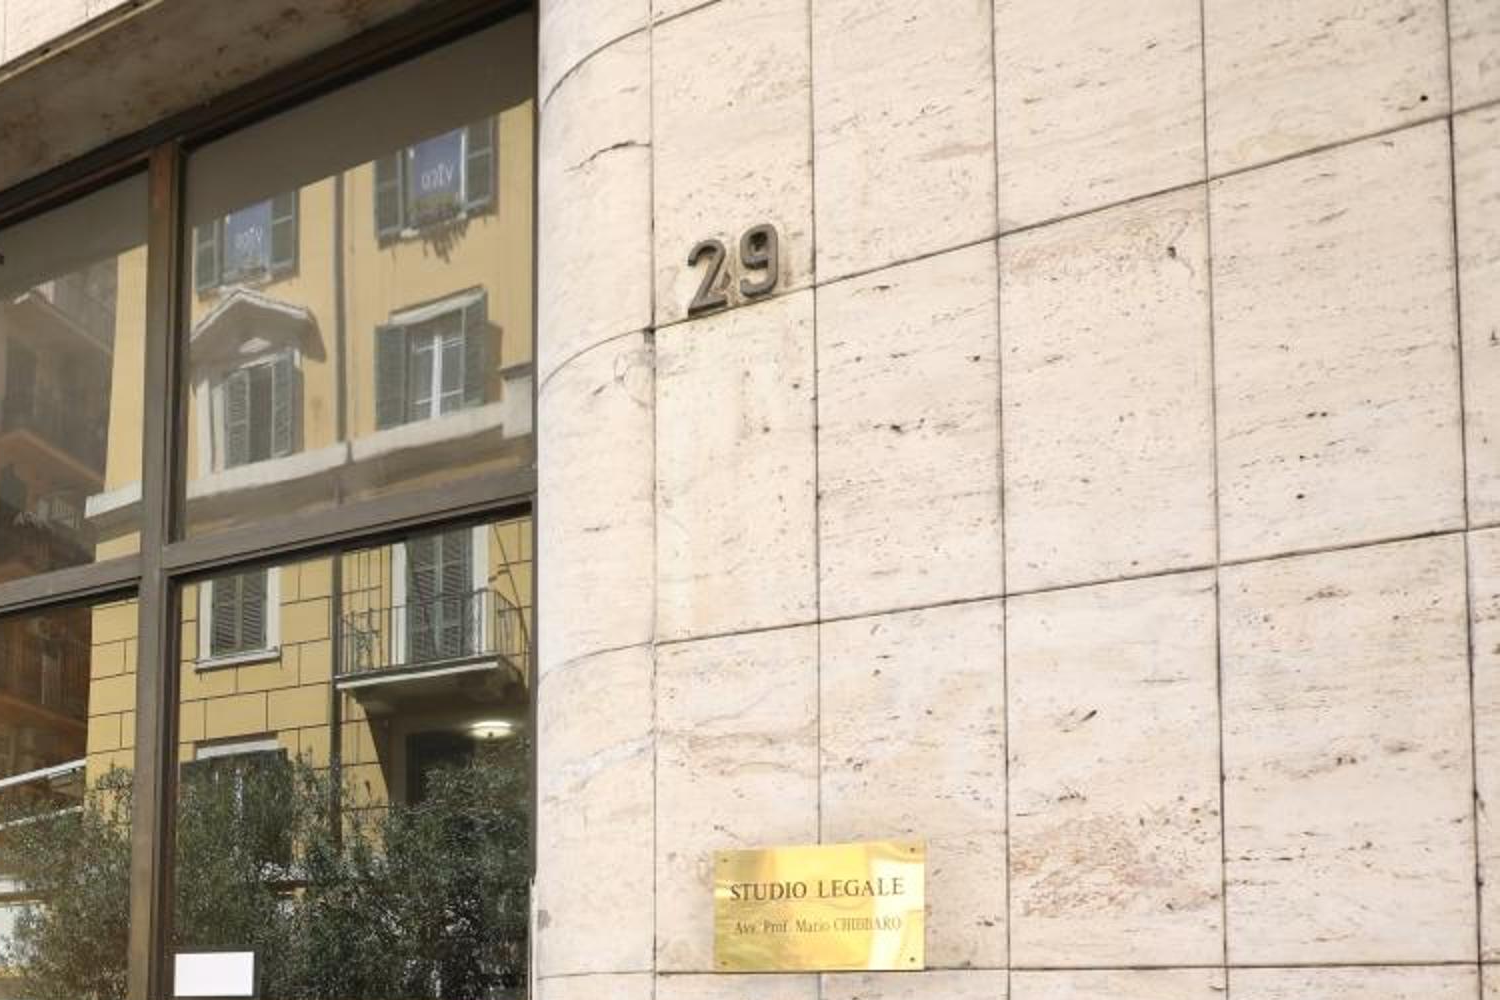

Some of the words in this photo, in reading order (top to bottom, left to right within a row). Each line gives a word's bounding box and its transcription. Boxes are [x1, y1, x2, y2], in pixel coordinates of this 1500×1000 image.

[687, 223, 779, 317] 29
[729, 881, 807, 901] STUDIO
[818, 877, 905, 899] LEGALE
[796, 918, 829, 933] Mario
